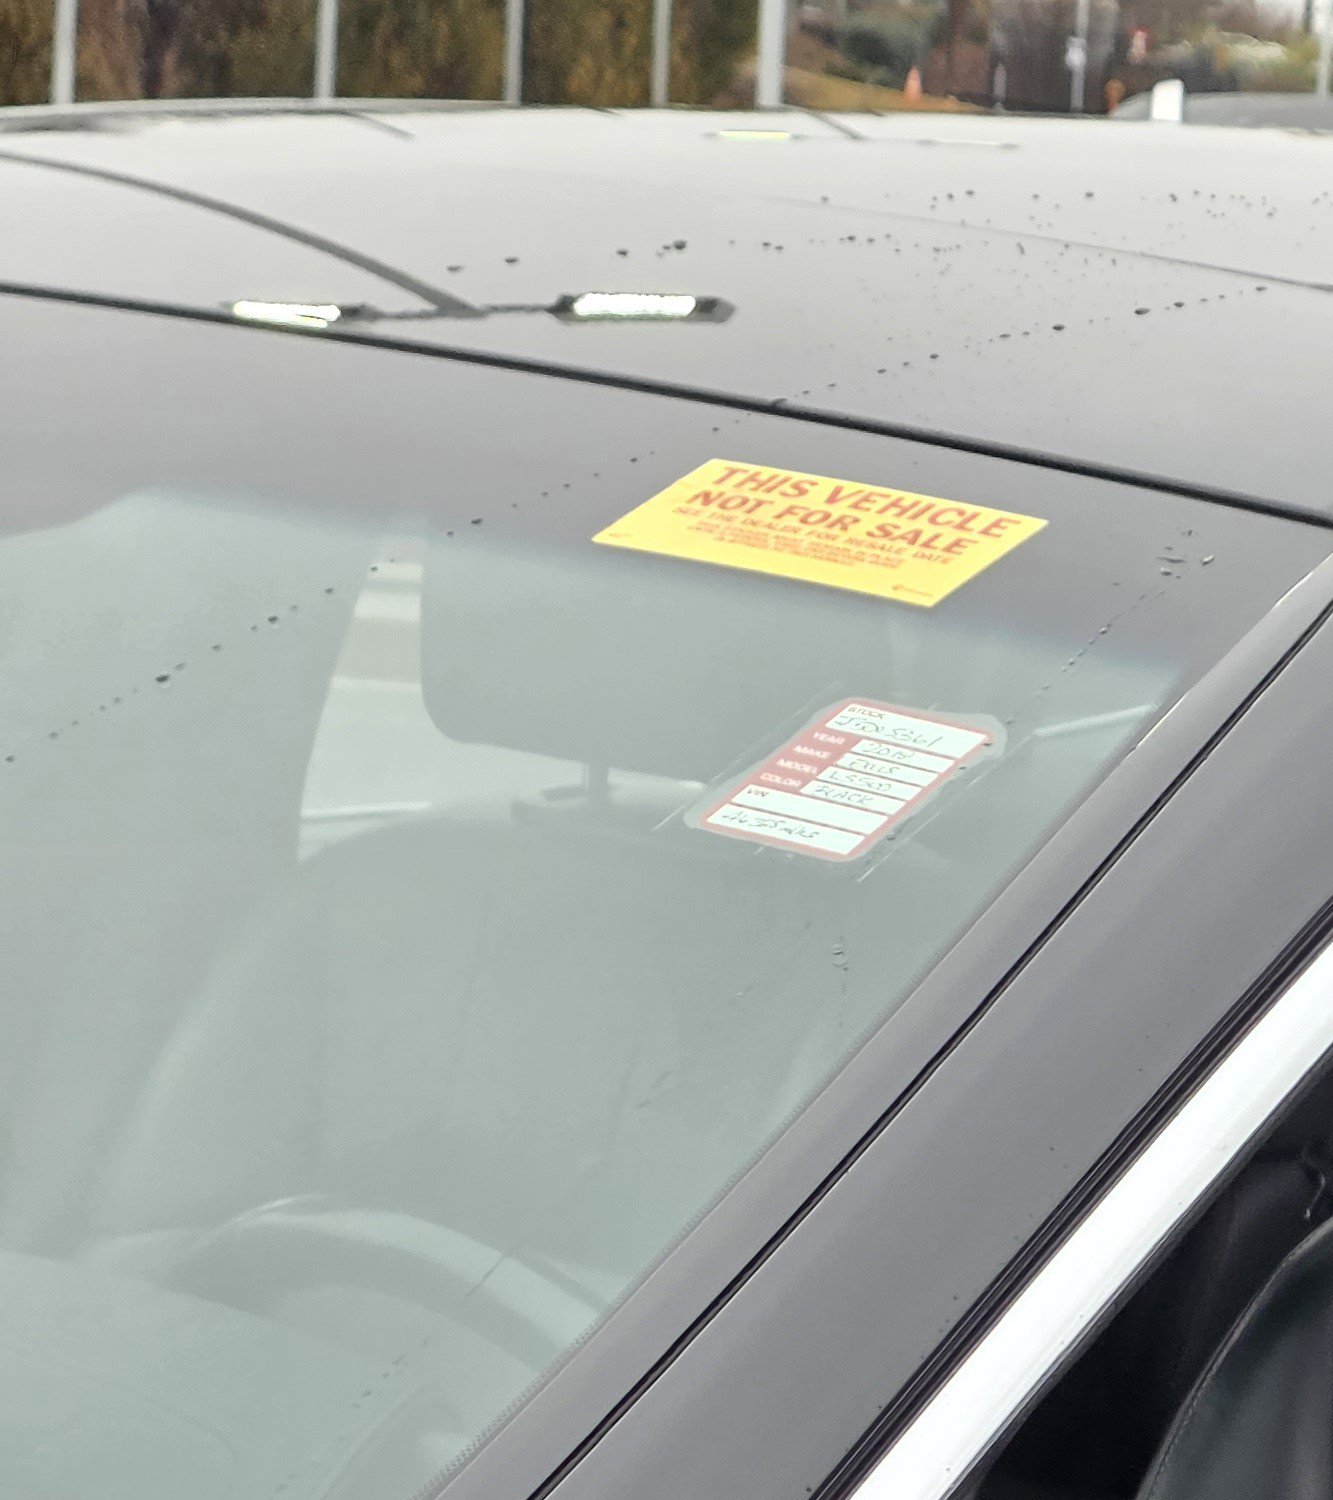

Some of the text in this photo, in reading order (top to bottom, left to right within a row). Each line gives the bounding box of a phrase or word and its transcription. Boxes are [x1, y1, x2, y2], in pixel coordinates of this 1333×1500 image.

[686, 489, 774, 515] NOT
[773, 504, 861, 532] FOR
[866, 522, 978, 556] SALE
[712, 467, 1021, 538] THIS VEHICLE
[912, 551, 955, 565] DATE
